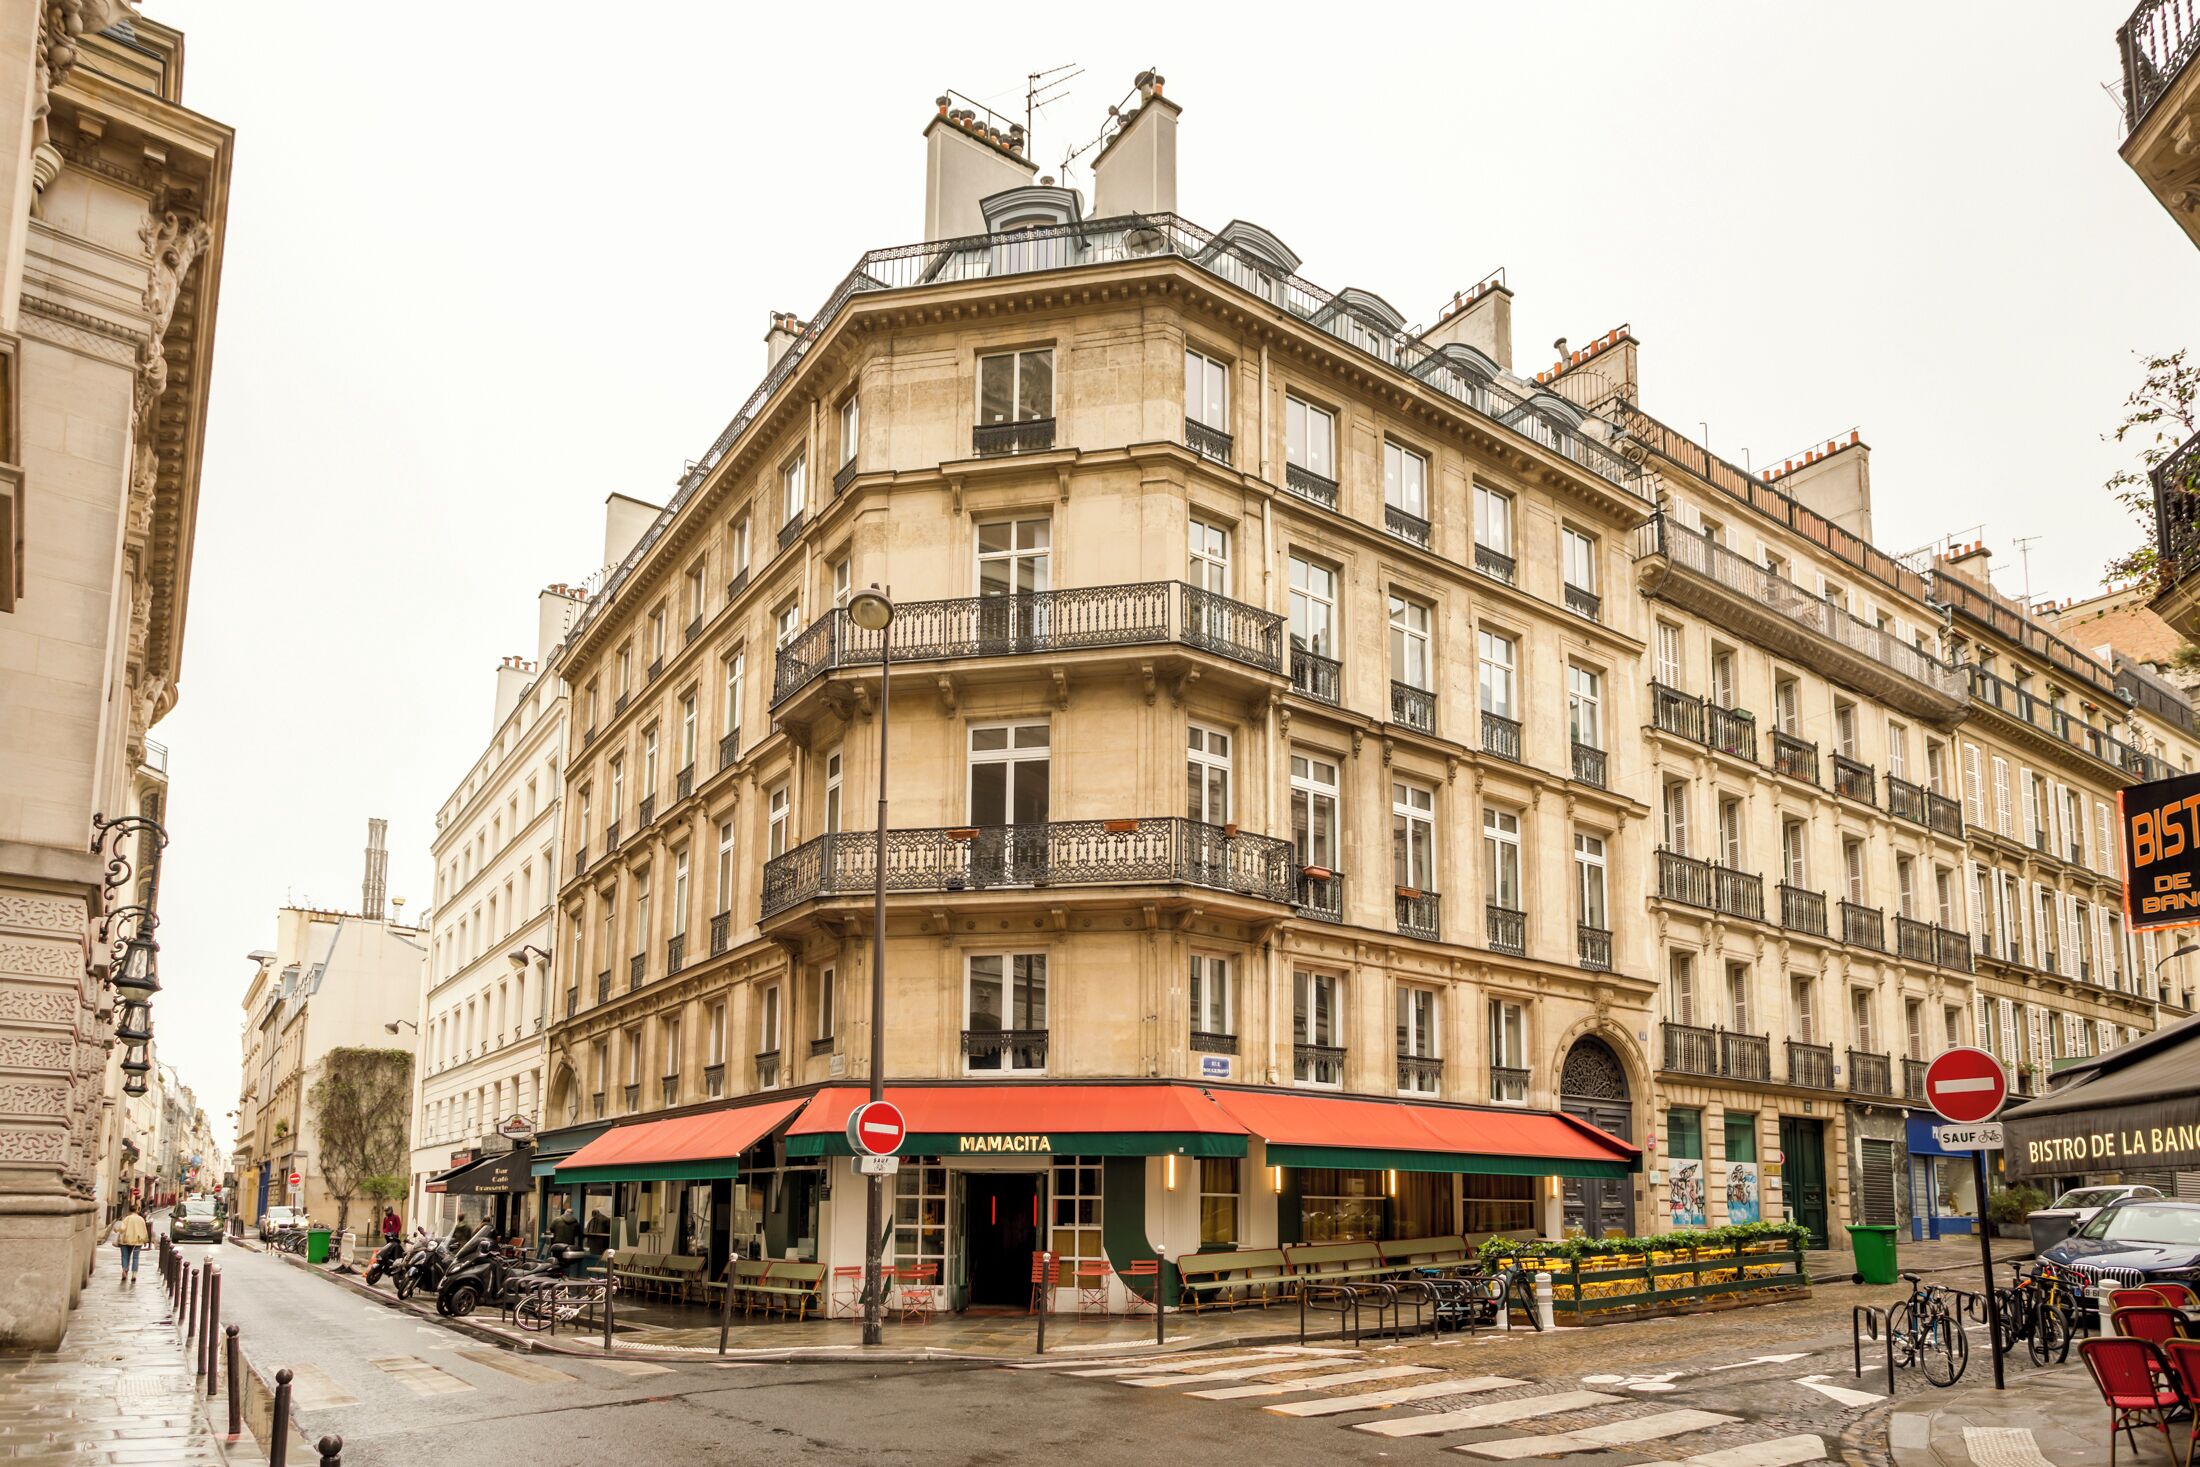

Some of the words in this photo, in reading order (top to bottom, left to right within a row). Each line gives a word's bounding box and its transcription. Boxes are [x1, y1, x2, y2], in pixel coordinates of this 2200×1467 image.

[2131, 793, 2200, 868] BIST
[2154, 871, 2192, 893] DE
[2142, 891, 2200, 914] BAN
[960, 1135, 1051, 1152] MAMACITA
[1942, 1132, 1977, 1144] SAUF
[2028, 1136, 2087, 1163] BISTRO
[2091, 1132, 2116, 1158] DE
[2121, 1130, 2146, 1155] LA
